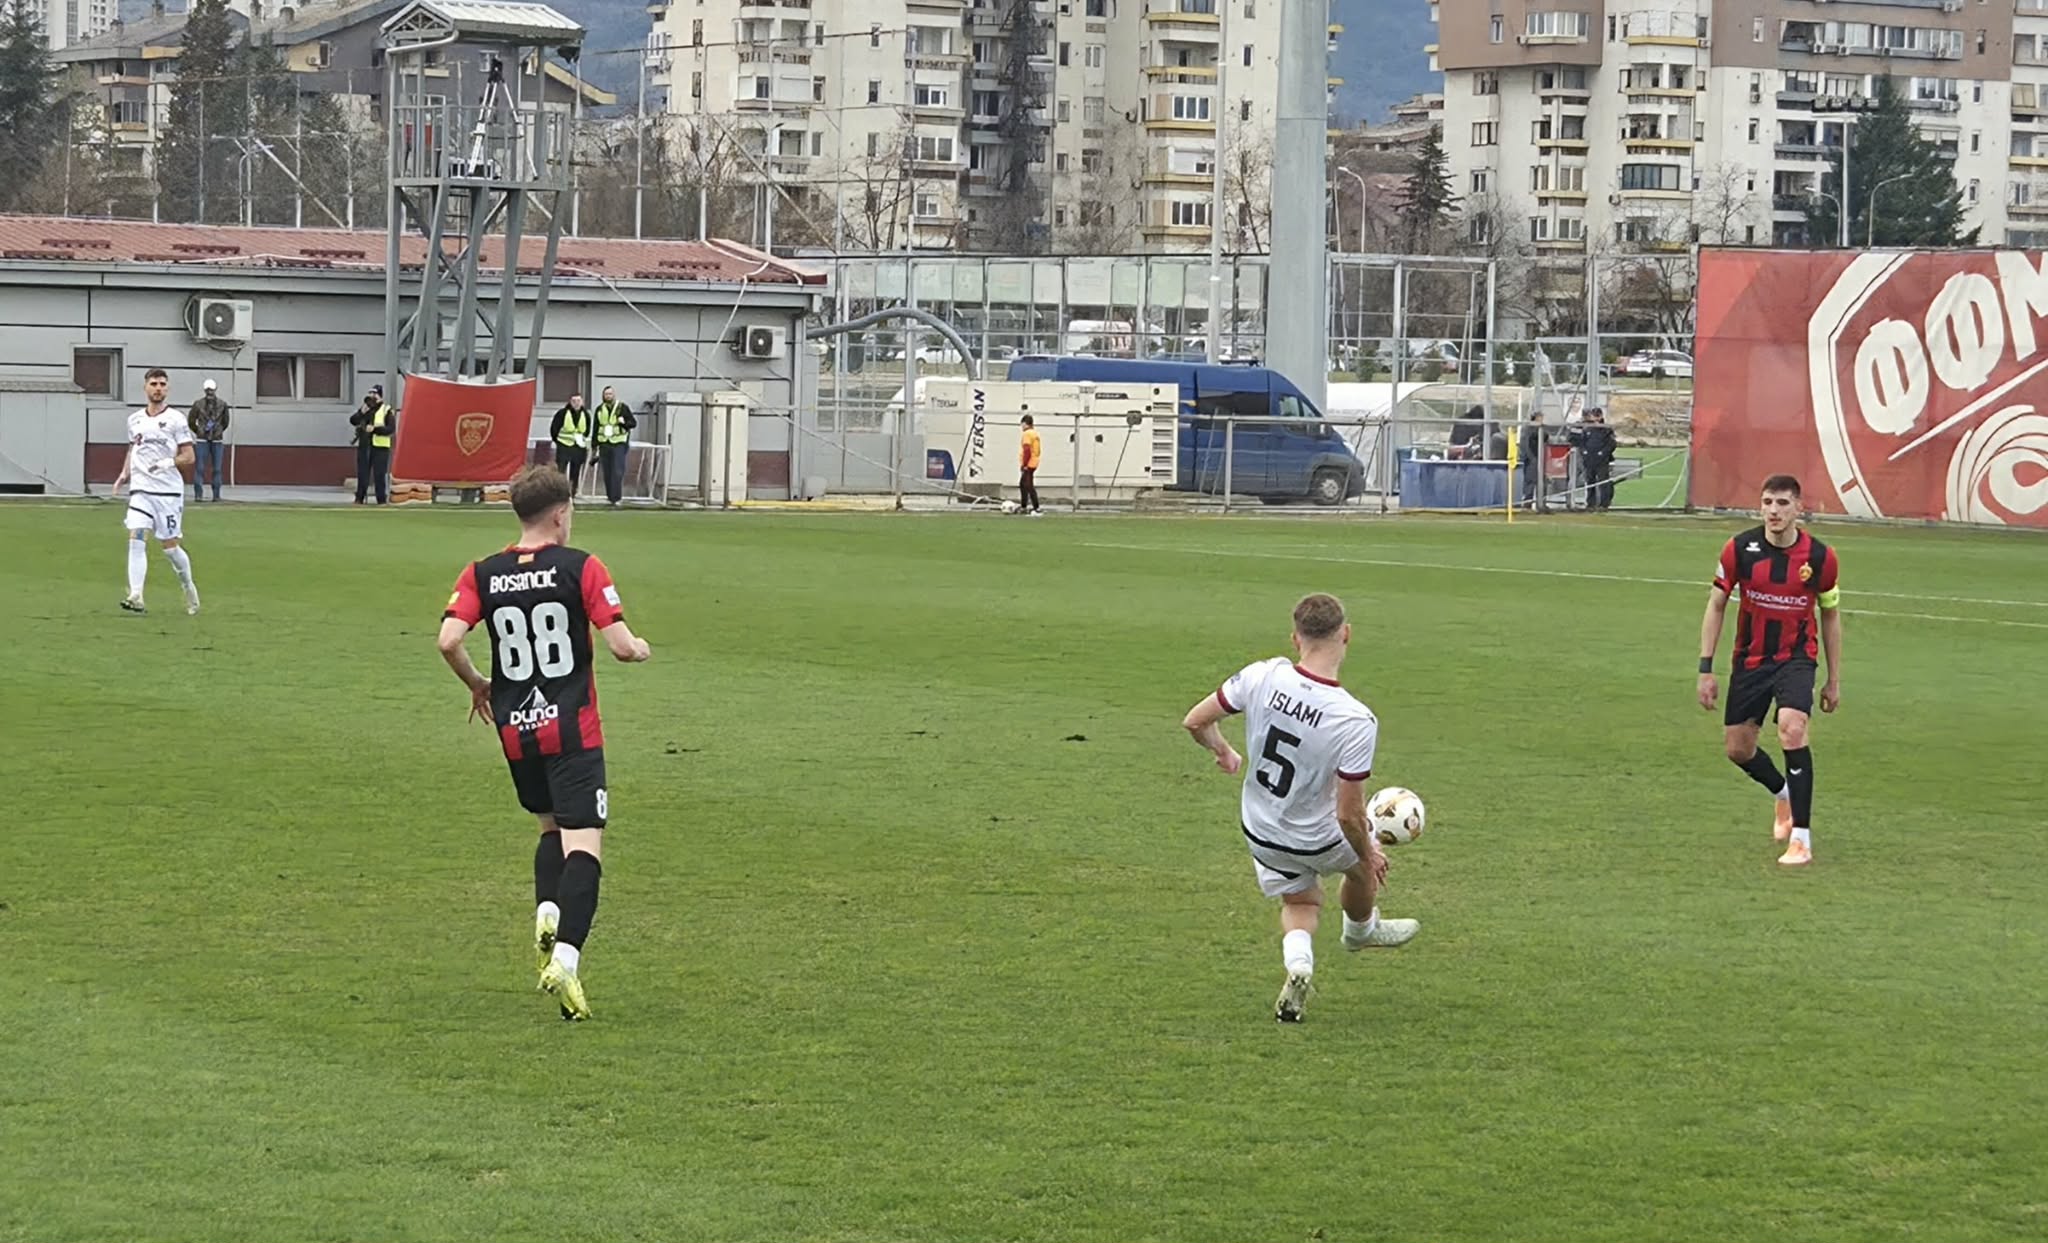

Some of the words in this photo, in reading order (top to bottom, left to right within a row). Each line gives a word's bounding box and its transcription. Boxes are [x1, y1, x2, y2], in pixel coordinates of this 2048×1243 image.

[973, 388, 985, 457] TEKSAN
[166, 514, 177, 529] 15
[492, 601, 575, 681] 88
[1268, 690, 1323, 728] ISLAMI
[1256, 724, 1301, 799] 5
